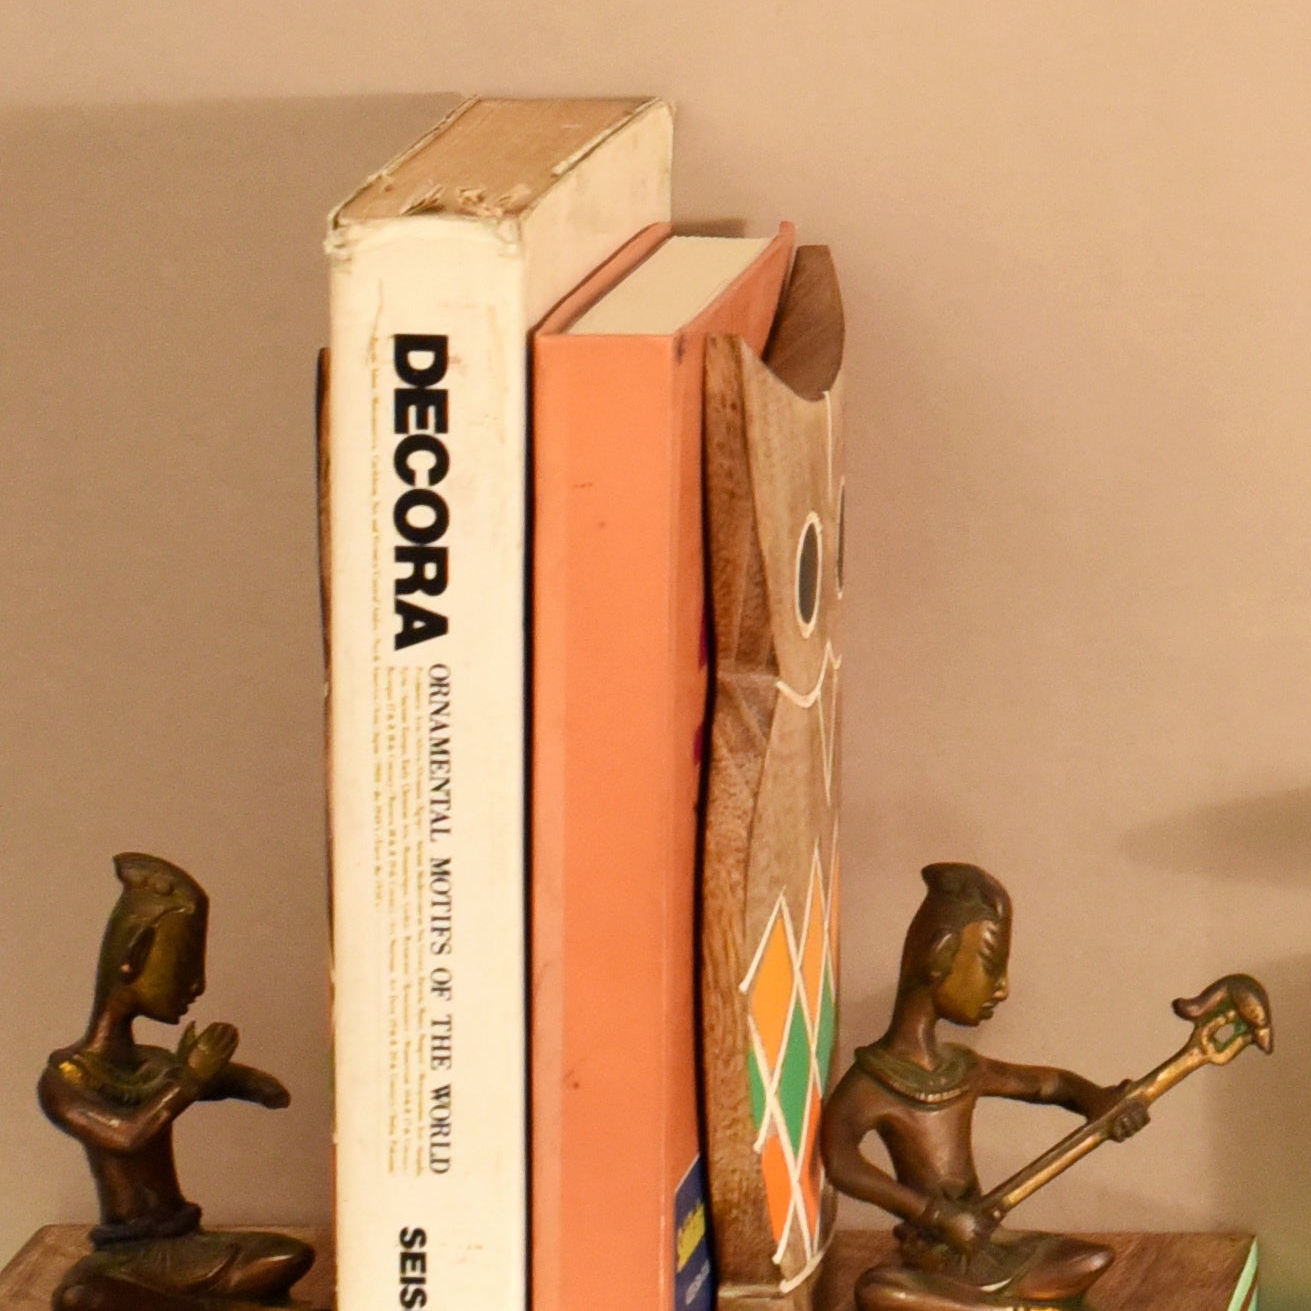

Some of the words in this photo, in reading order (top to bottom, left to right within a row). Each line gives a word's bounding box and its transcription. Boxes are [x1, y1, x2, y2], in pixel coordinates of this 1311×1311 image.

[393, 333, 450, 651] DECORA
[428, 662, 453, 843] ORNAMENTAL
[429, 857, 454, 956] MOTIFS
[430, 967, 453, 1002] OF
[430, 1013, 453, 1071] THE
[428, 1082, 453, 1175] WORLD
